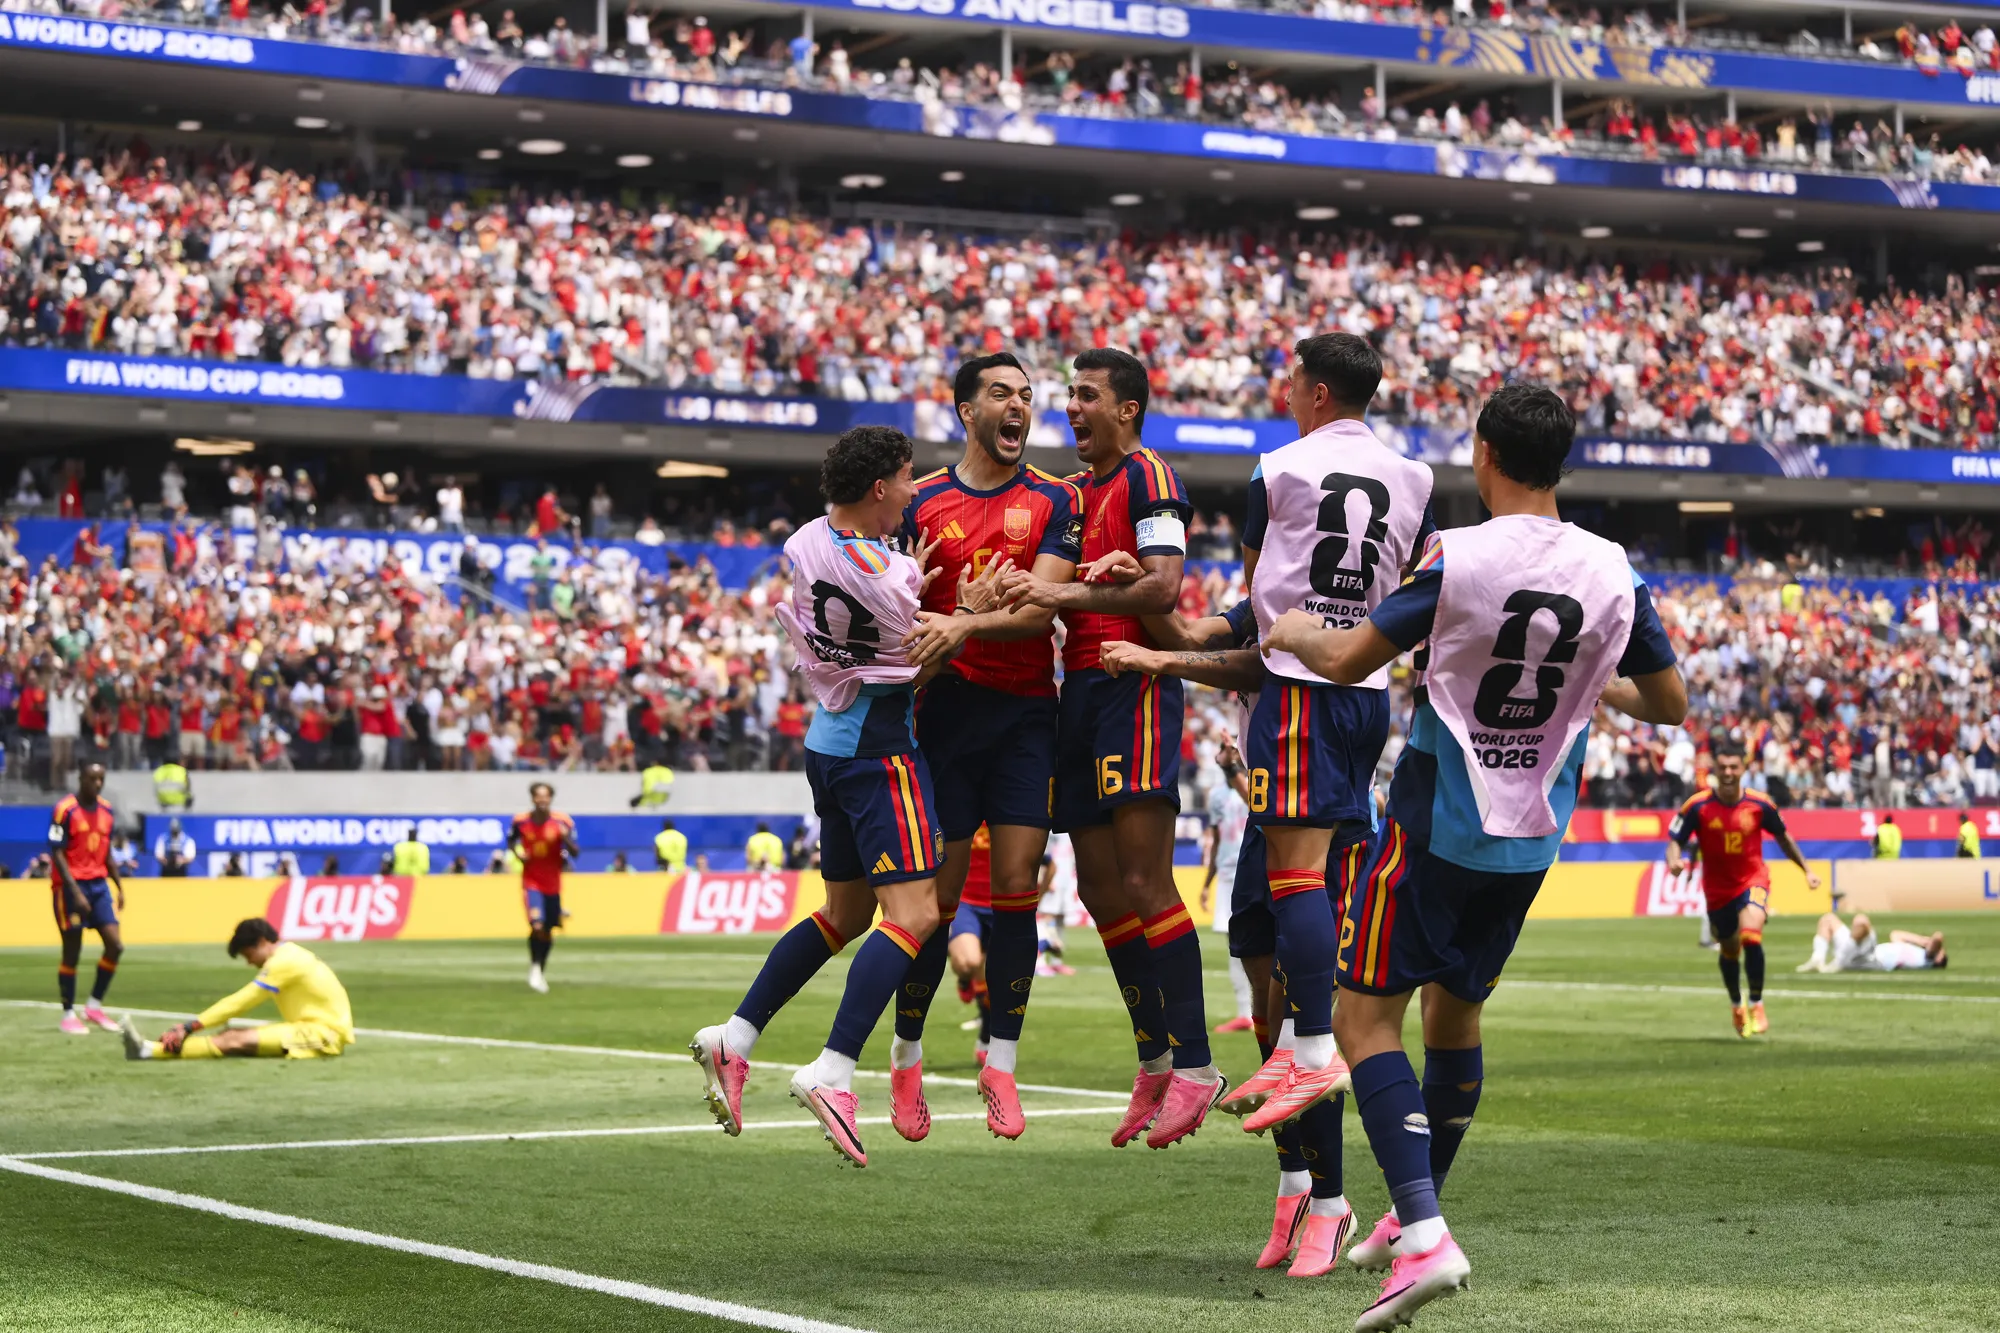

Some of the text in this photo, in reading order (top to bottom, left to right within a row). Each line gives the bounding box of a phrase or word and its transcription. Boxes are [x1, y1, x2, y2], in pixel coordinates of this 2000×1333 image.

[14, 16, 109, 48] WORLD
[110, 26, 164, 54] CUP
[66, 358, 121, 386] FIFA
[120, 362, 209, 391] WORLD
[209, 368, 260, 394] CUP
[1952, 455, 1989, 478] FIFA
[1332, 574, 1364, 591] FIFA
[1304, 599, 1369, 618] WORLD CU
[1498, 703, 1536, 718] FIFA
[1469, 731, 1545, 747] WORLD CUP
[1096, 754, 1124, 800] 16
[1248, 768, 1270, 813] 8
[214, 819, 273, 846] FIFA
[272, 819, 365, 846] WORLD
[365, 818, 417, 846] CUP
[1724, 831, 1743, 855] 12
[280, 874, 400, 942] Lay's
[676, 871, 787, 934] Lay's
